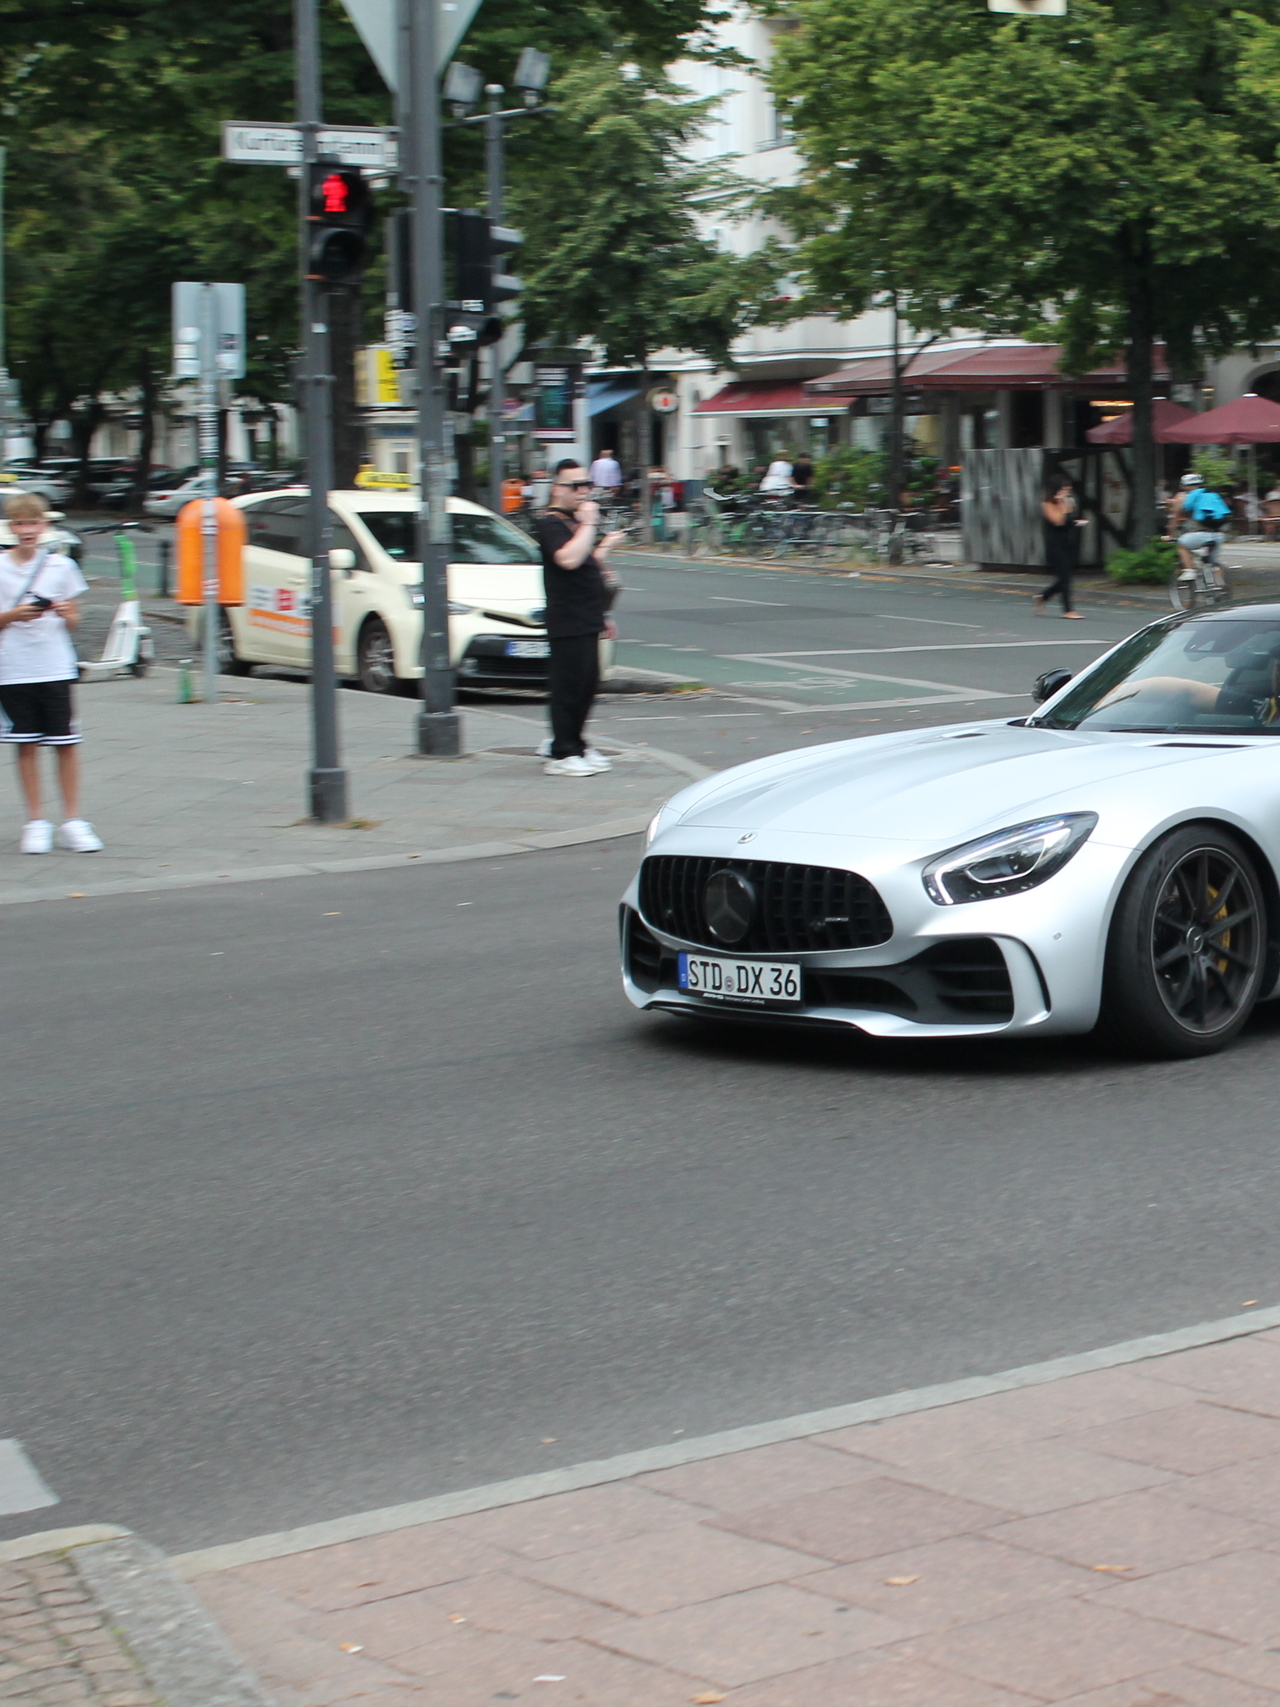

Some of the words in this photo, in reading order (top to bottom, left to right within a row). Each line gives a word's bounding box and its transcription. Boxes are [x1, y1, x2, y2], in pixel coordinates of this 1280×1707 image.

[235, 130, 385, 155] Kurfürsndamm
[689, 960, 722, 990] STD
[736, 965, 764, 995] DX
[770, 967, 797, 997] 36
